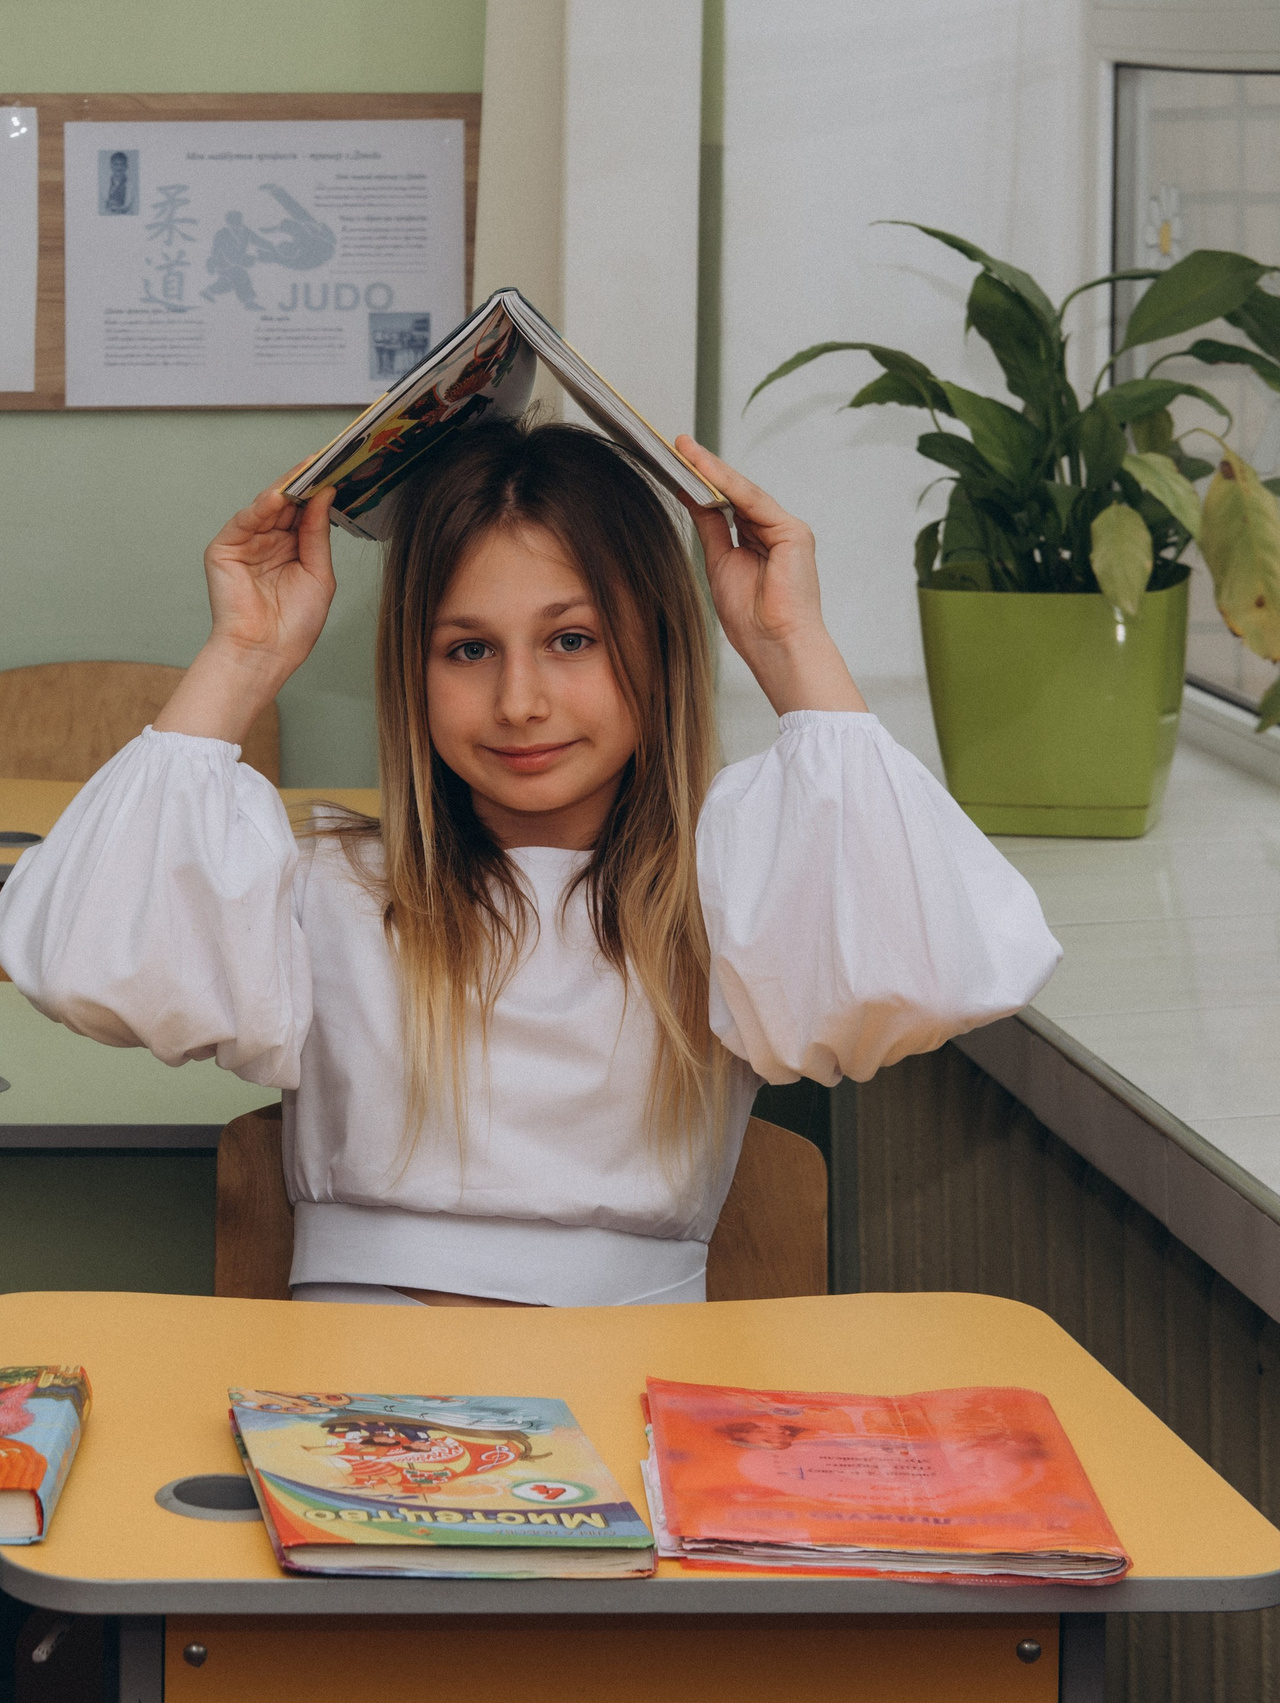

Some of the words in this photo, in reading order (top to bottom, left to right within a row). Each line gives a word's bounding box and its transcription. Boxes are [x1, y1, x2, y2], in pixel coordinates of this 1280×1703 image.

[140, 183, 200, 312] 柔道
[278, 282, 395, 313] JUDO
[528, 1483, 568, 1501] 4
[304, 1508, 610, 1530] Мистецтво
